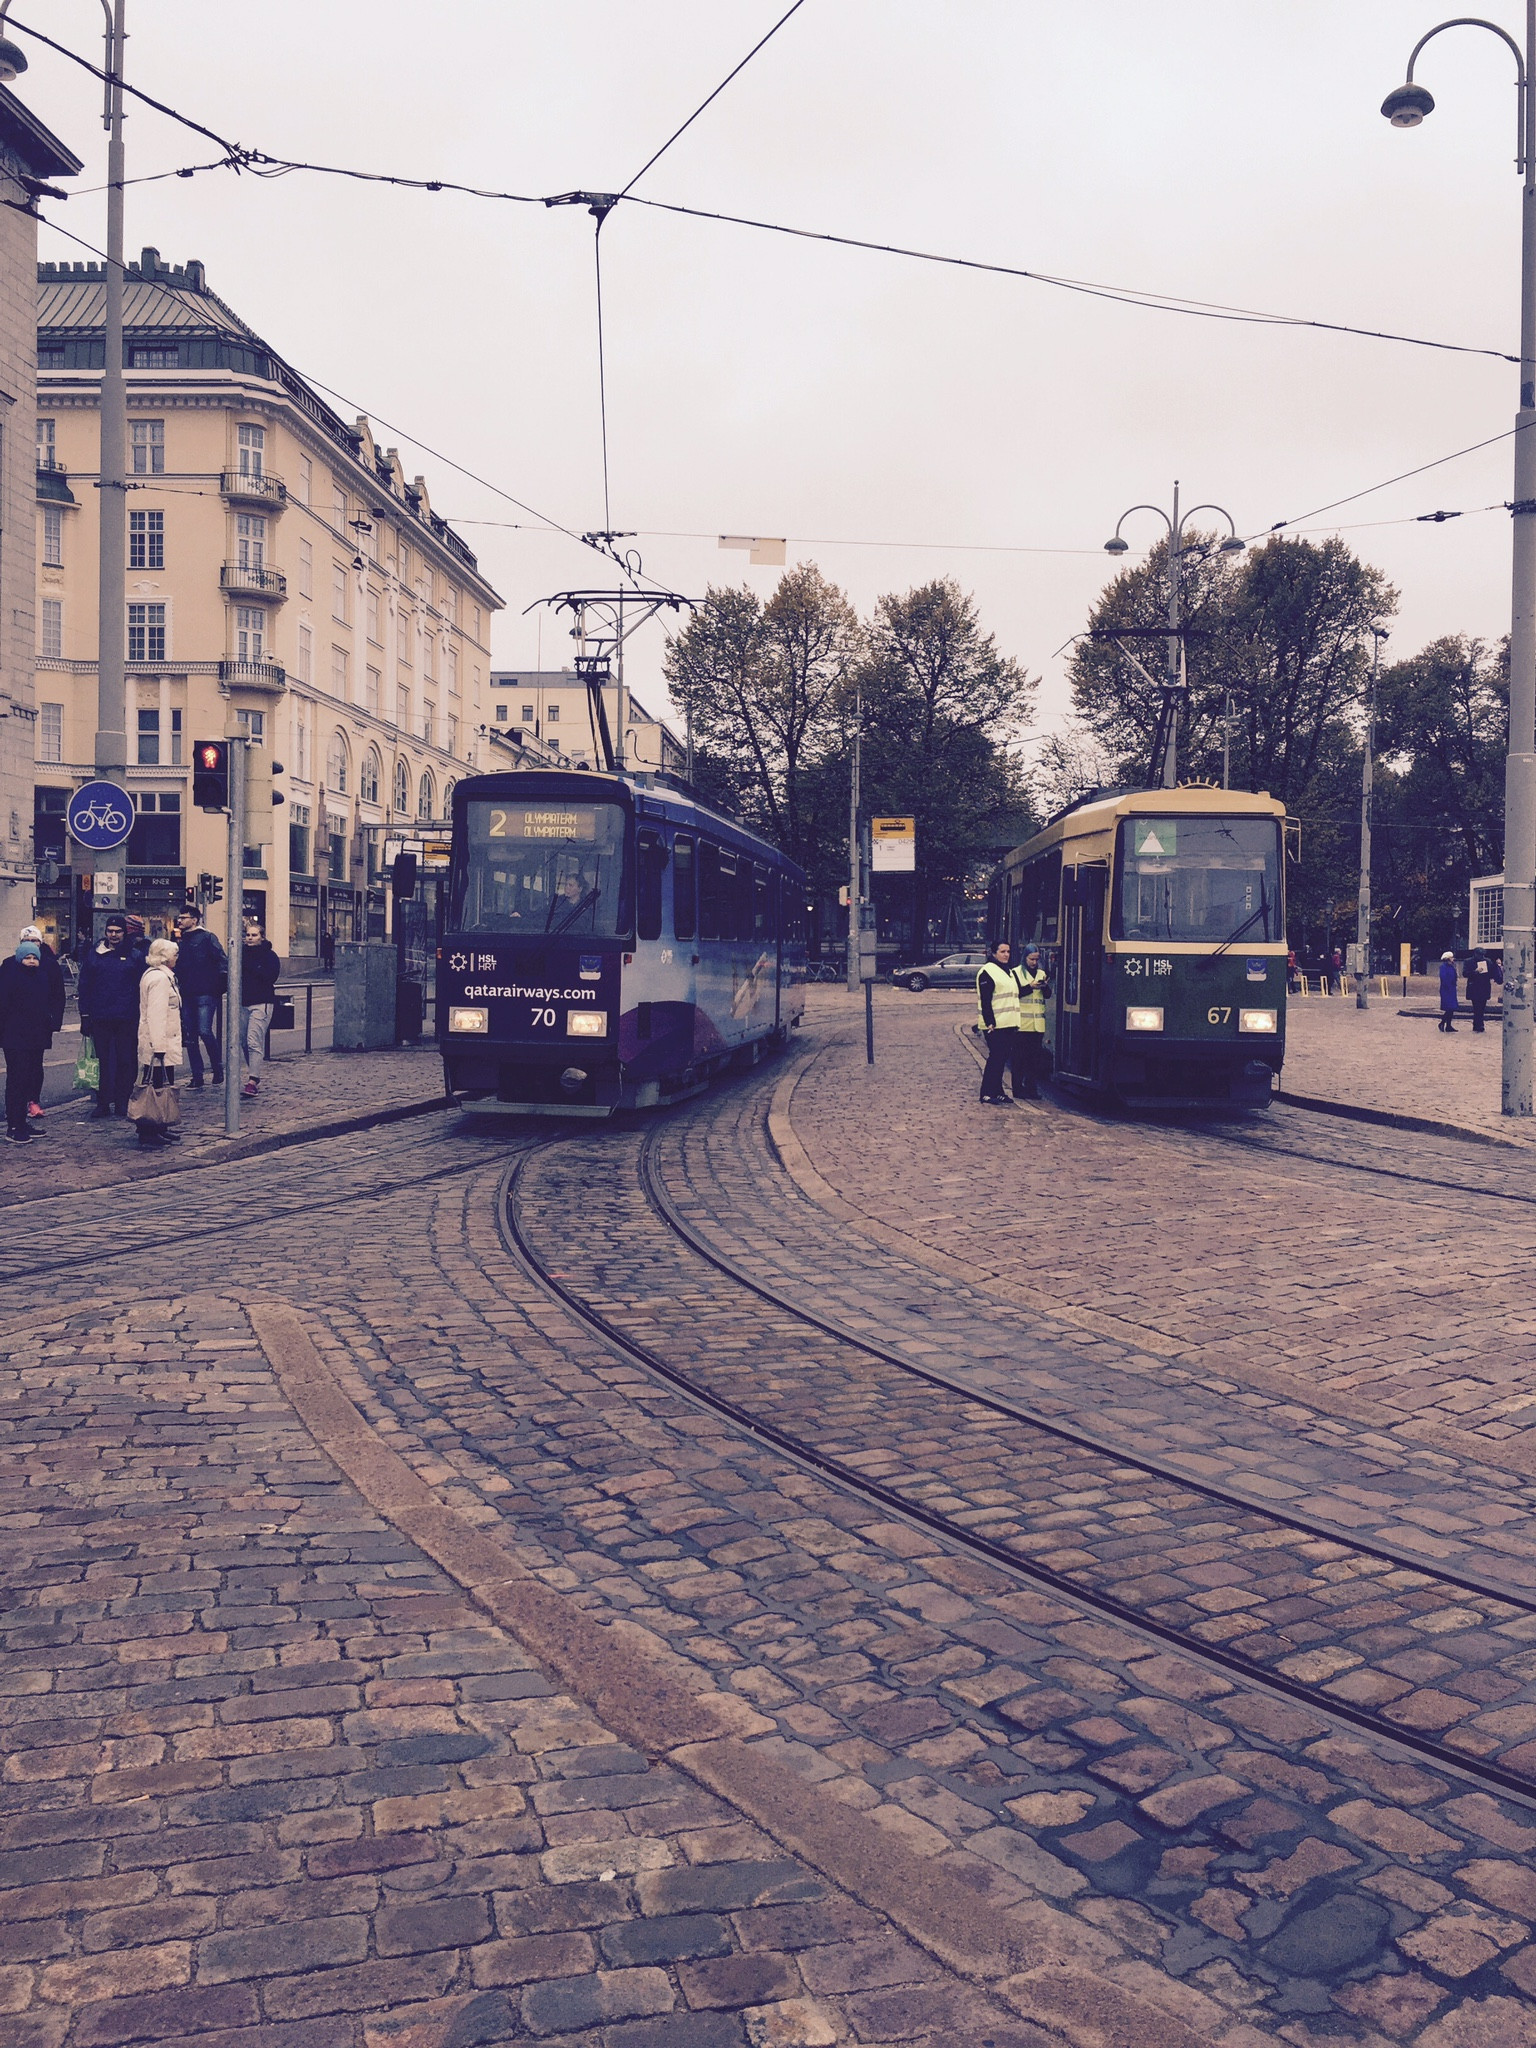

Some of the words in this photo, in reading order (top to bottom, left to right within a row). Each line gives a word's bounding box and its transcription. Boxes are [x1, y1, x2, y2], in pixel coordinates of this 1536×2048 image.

[489, 809, 507, 837] 2
[478, 954, 497, 963] HSL
[1153, 959, 1172, 969] HSL
[478, 962, 497, 971] HRT
[1153, 967, 1172, 976] HRT
[464, 984, 596, 1002] qatarairways.com
[531, 1008, 556, 1027] 70
[1207, 1007, 1231, 1024] 67
